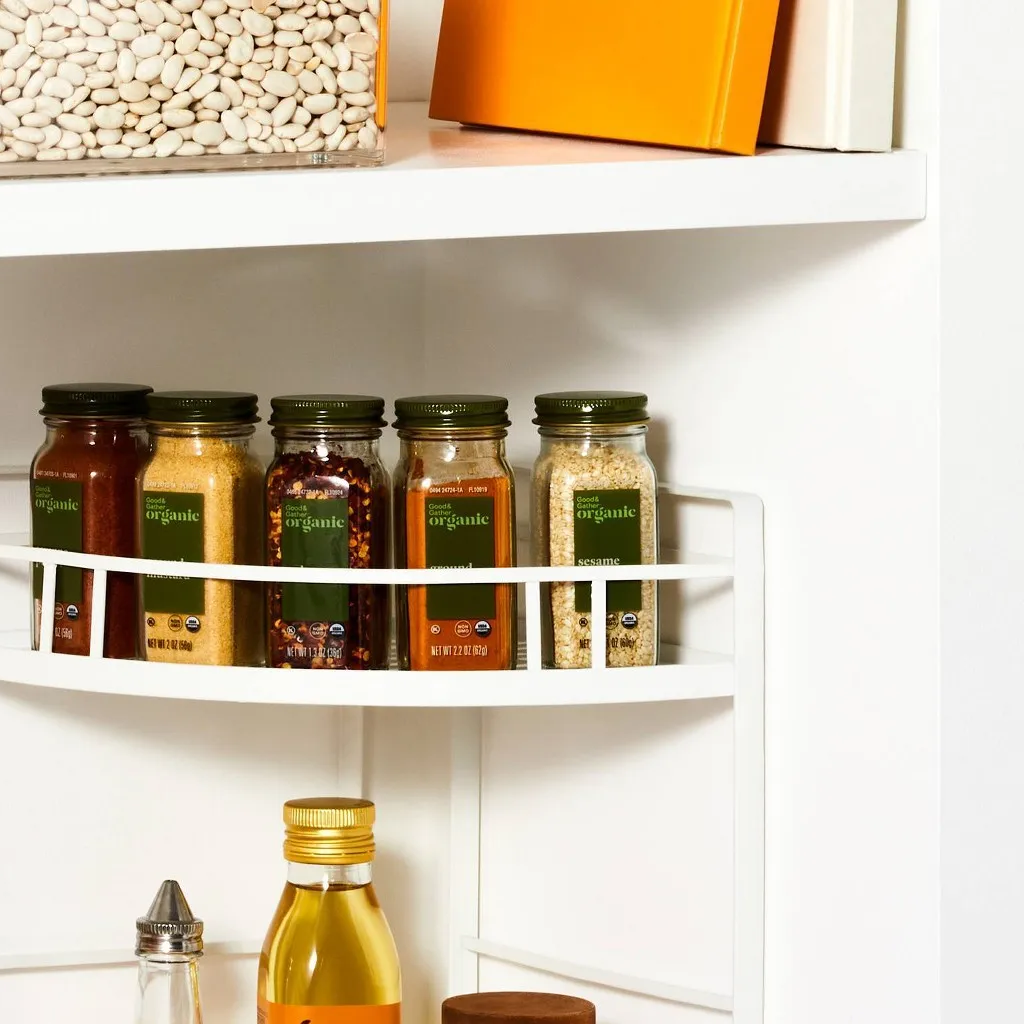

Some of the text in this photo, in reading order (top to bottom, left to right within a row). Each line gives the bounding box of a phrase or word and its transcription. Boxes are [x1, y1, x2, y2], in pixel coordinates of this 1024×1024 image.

[35, 497, 79, 514] organic
[146, 509, 200, 525] organic
[285, 510, 307, 518] Gather
[576, 505, 636, 524] organic
[285, 515, 345, 533] organic
[428, 512, 490, 531] organic
[577, 557, 620, 566] sesame
[147, 638, 178, 650] NET WT 2 OZ
[431, 645, 442, 656] NET
[442, 645, 452, 656] WT
[453, 645, 463, 656] 2.2
[463, 645, 471, 656] OZ
[287, 646, 297, 657] NET
[298, 646, 307, 657] WT
[318, 647, 326, 658] OZ
